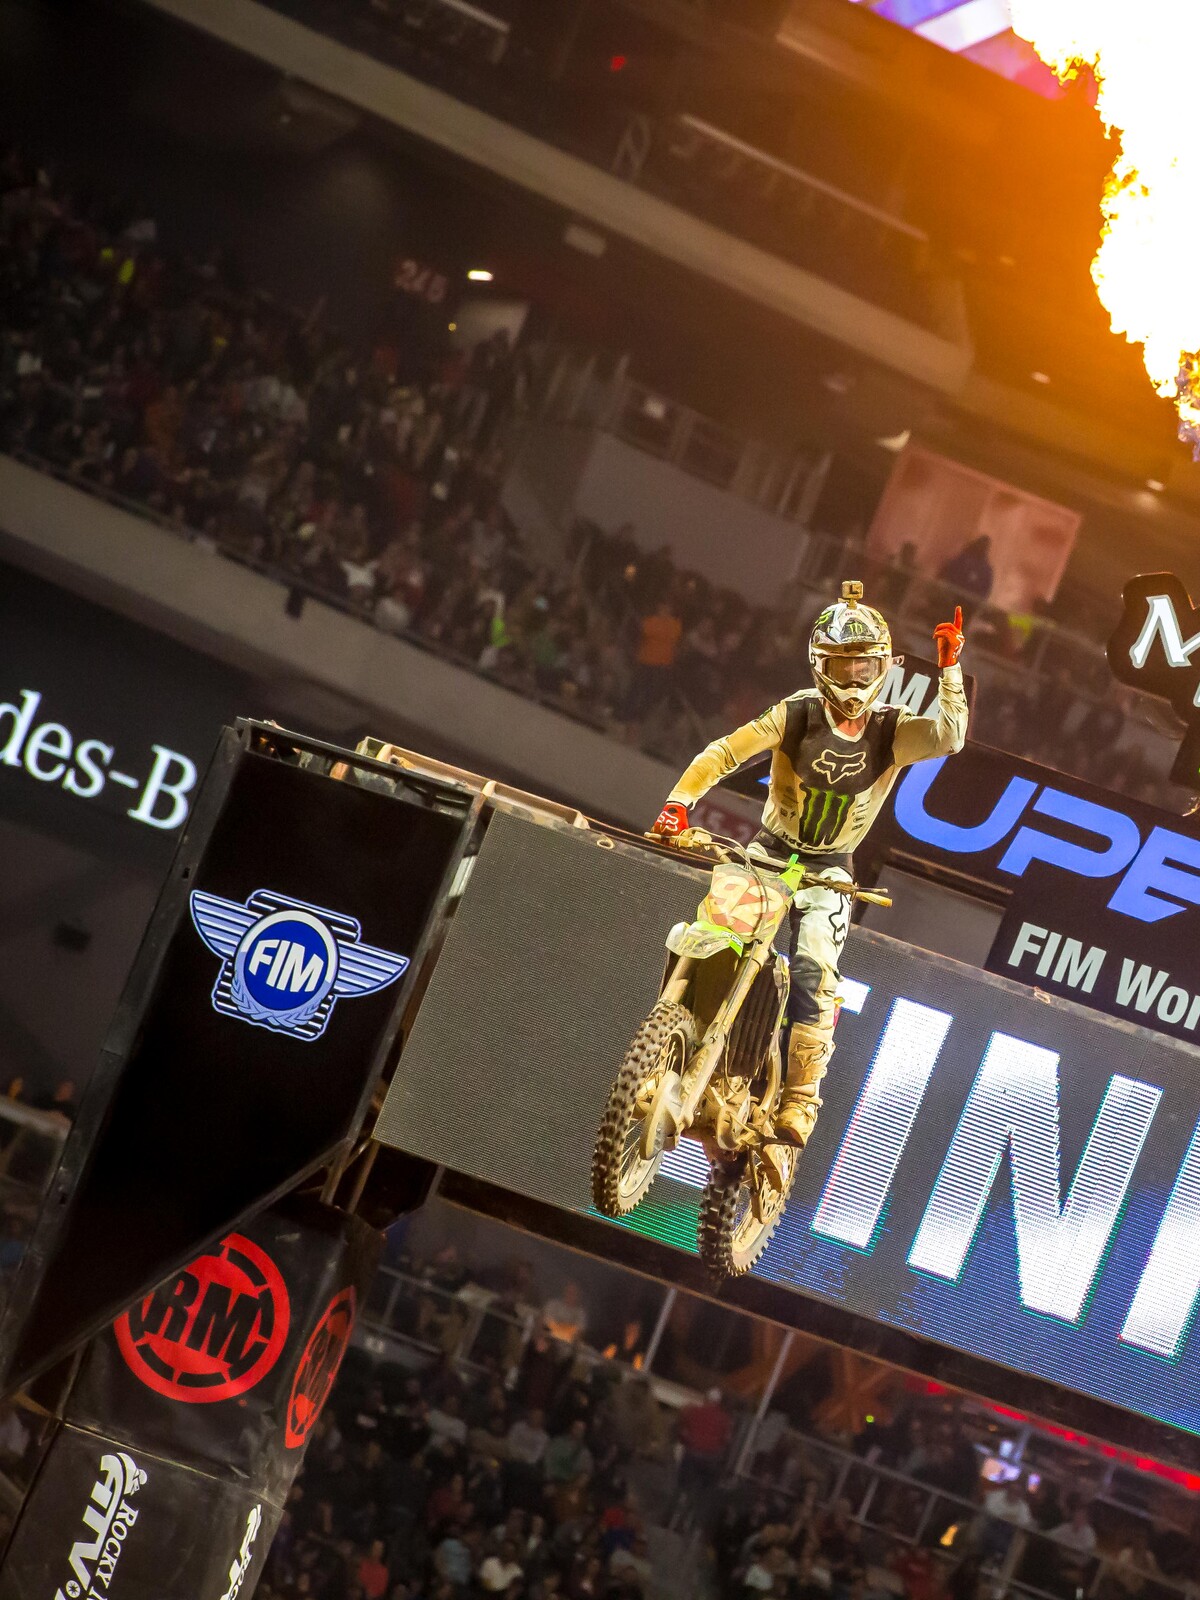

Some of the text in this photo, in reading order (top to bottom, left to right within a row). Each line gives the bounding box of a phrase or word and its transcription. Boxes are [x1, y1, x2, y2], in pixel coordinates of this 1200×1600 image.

[248, 938, 326, 994] FIM
[1007, 921, 1107, 992] FIM
[96, 1499, 139, 1589] ROCKY
